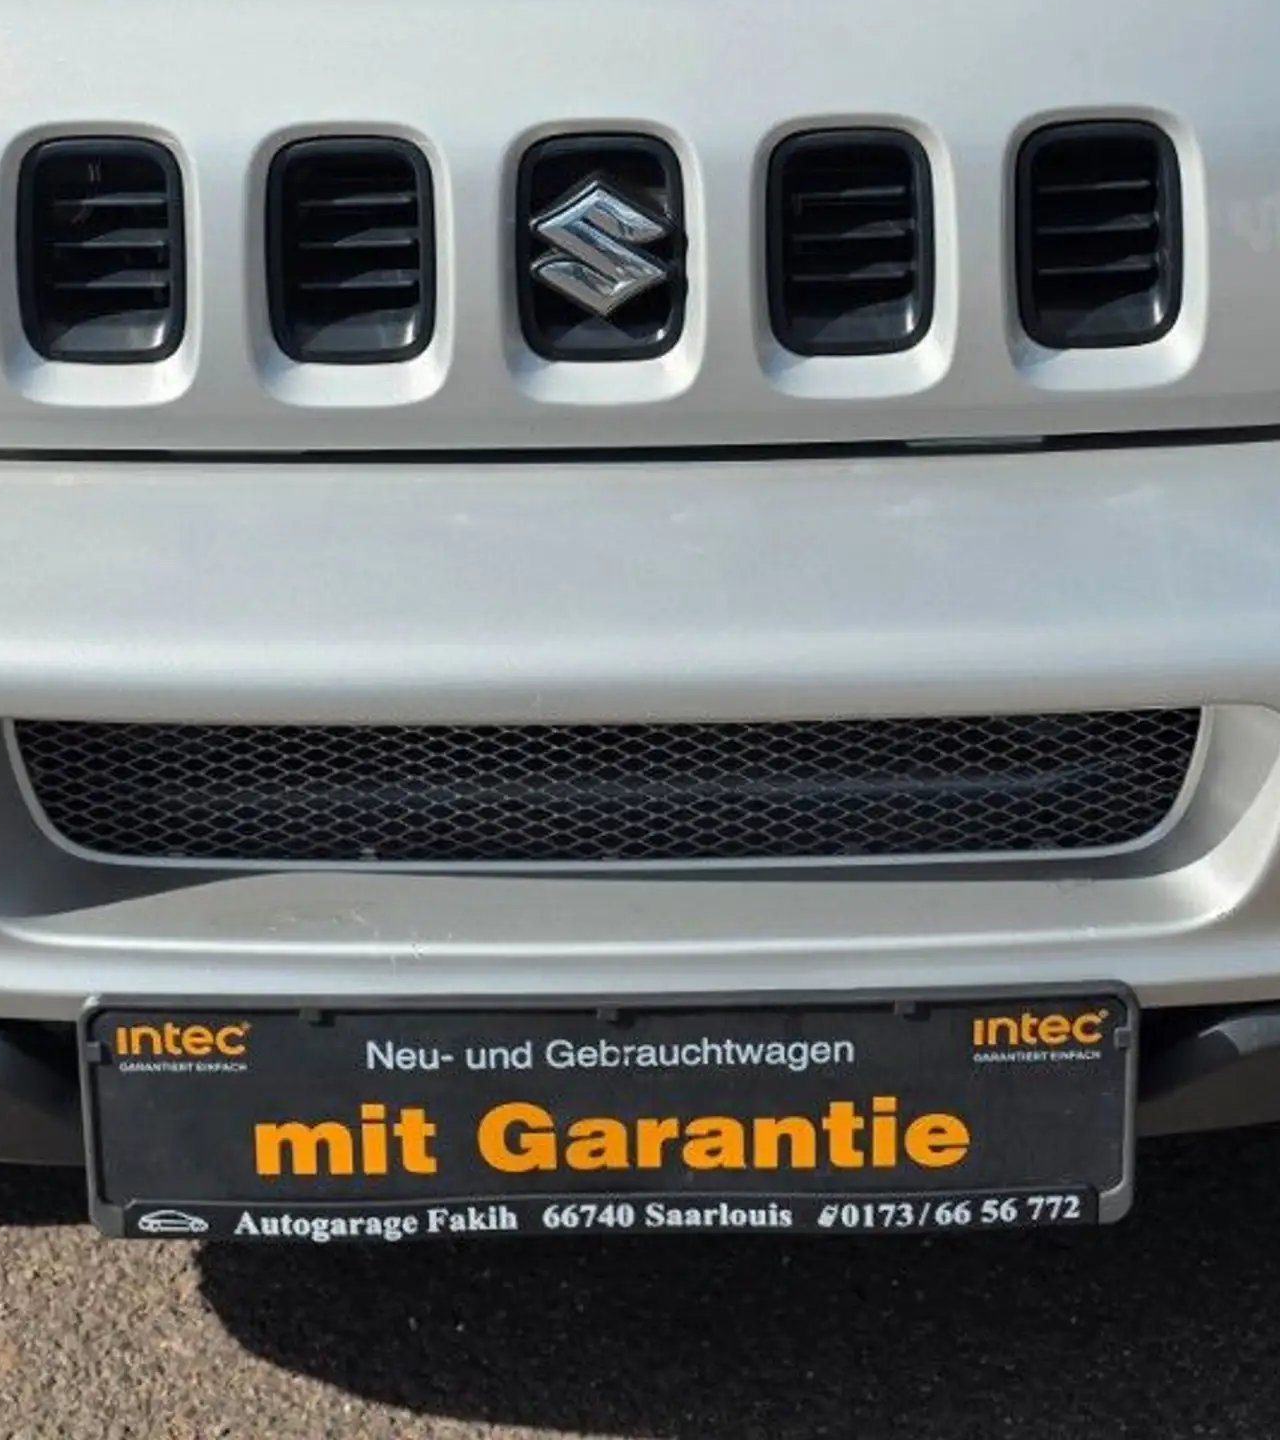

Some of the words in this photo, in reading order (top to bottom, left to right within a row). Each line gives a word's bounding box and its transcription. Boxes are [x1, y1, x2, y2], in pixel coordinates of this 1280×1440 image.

[366, 1040, 454, 1070] Neu-
[466, 1041, 533, 1070] und
[545, 1038, 855, 1071] Gebrauchtwagen
[255, 1104, 437, 1176] mit
[477, 1096, 969, 1173] Garantie
[234, 1210, 418, 1242] Autogarage
[426, 1205, 518, 1233] Fakih
[542, 1204, 634, 1228] 66740
[645, 1203, 793, 1228] Saarlouis
[980, 1198, 1018, 1223] 56
[1027, 1195, 1080, 1220] 772
